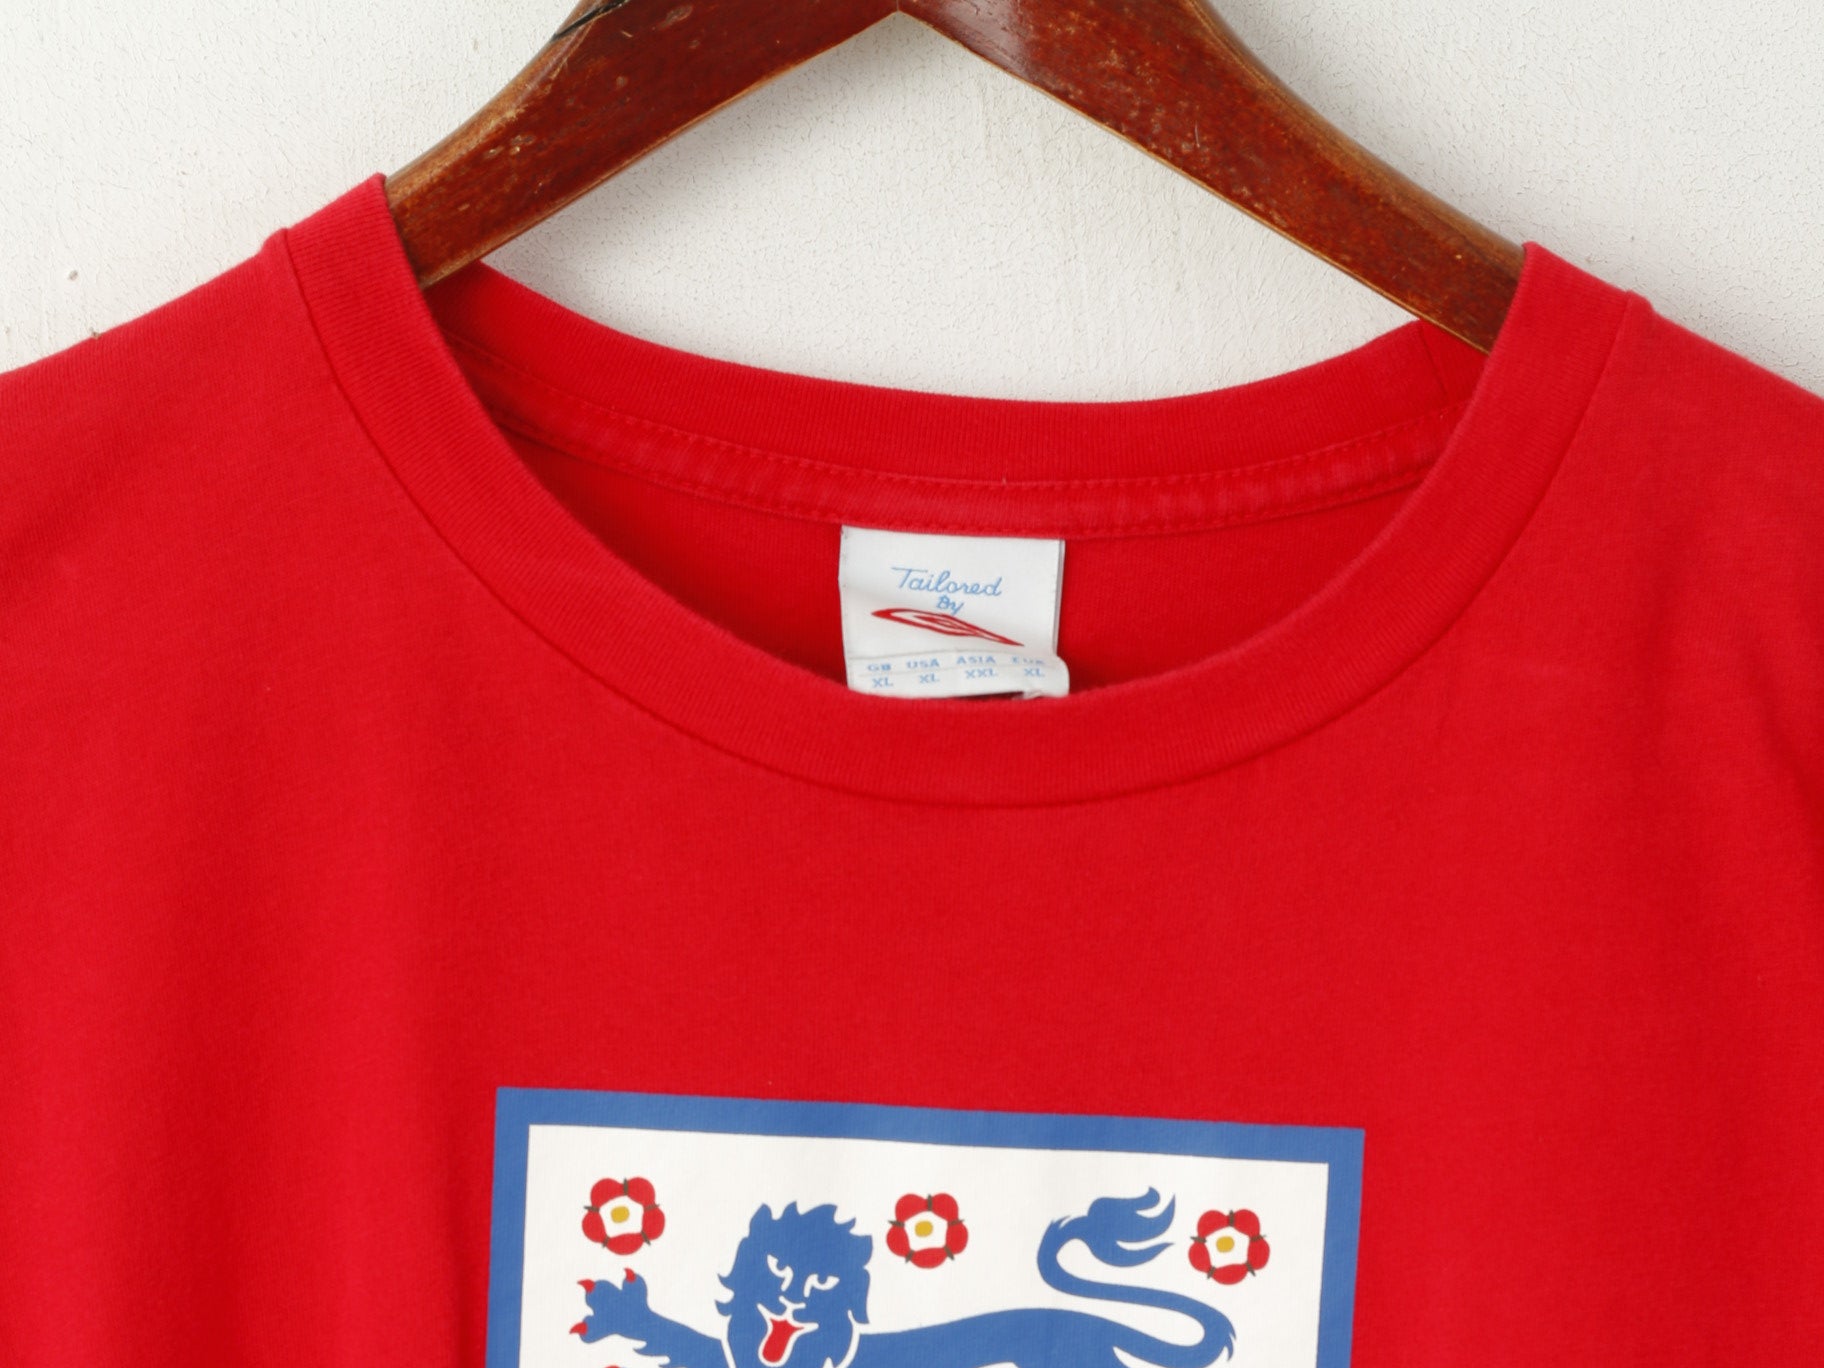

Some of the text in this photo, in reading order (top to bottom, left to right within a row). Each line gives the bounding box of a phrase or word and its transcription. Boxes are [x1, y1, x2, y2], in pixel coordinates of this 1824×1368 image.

[891, 567, 1002, 596] Tailored
[867, 663, 892, 672] GB
[906, 658, 940, 669] USA
[956, 655, 997, 665] ASIA
[872, 667, 1046, 688] XL XL XXL XL
